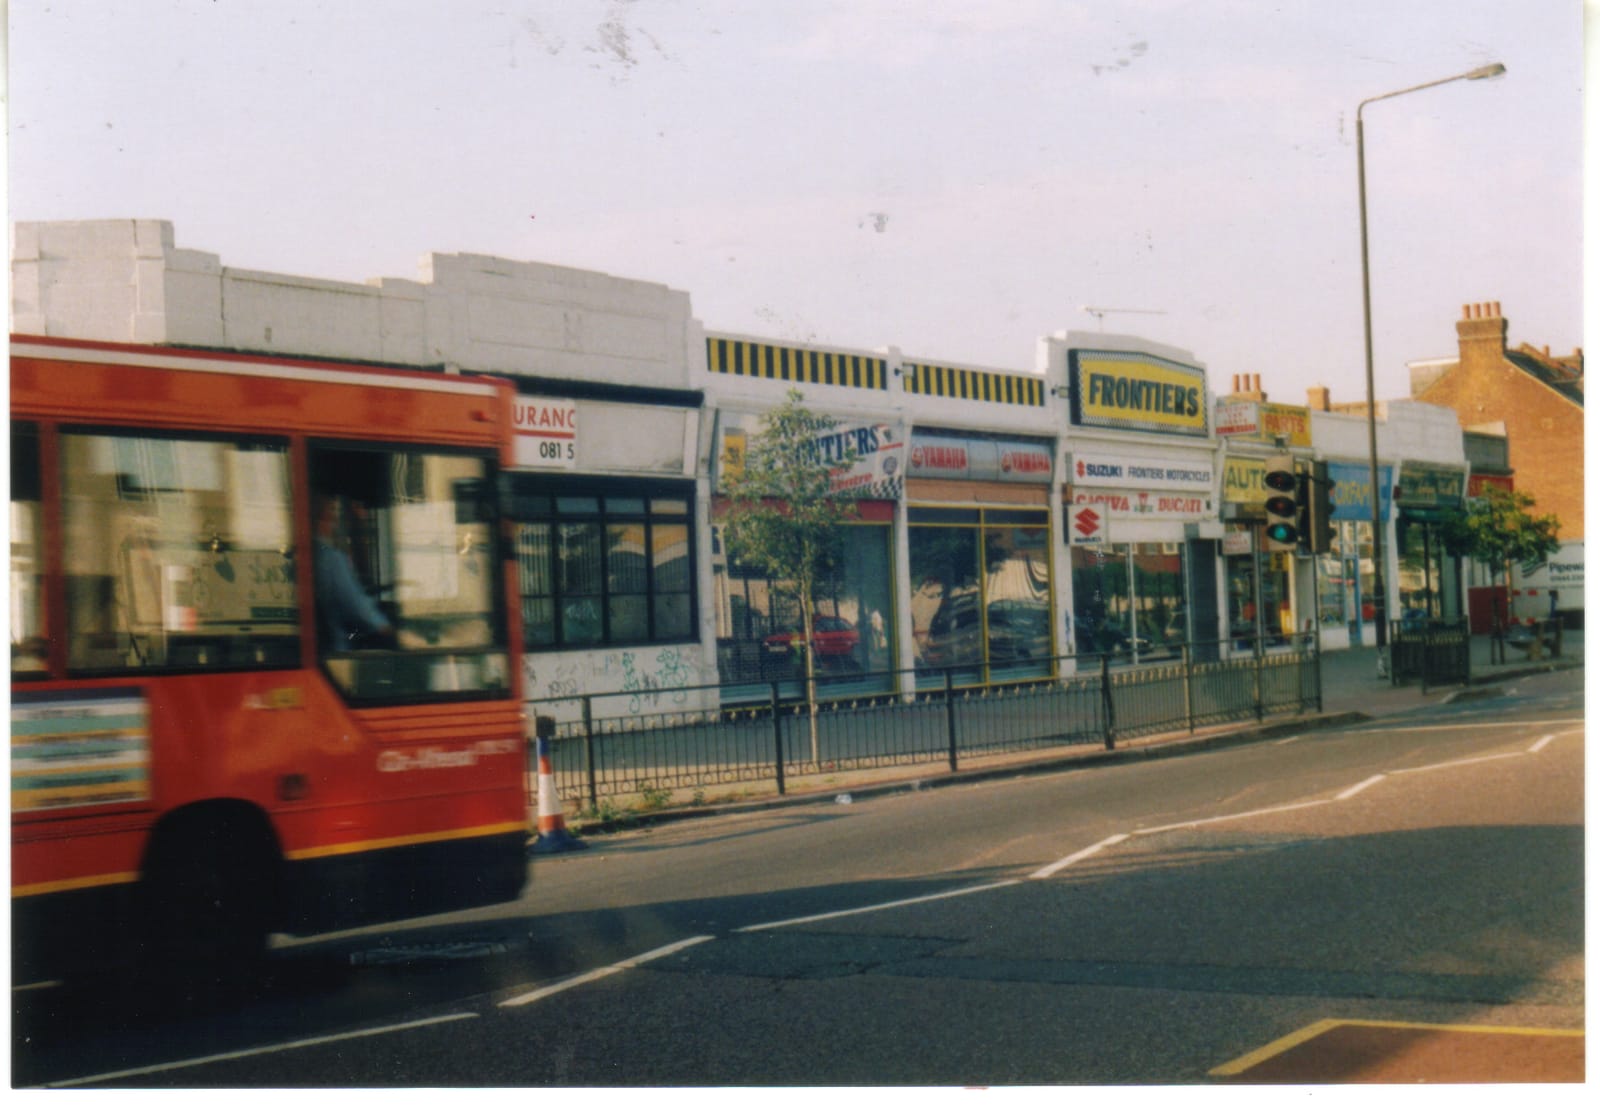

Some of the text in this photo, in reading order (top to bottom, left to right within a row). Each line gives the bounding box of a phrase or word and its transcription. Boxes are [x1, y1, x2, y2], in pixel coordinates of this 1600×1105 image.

[1088, 372, 1199, 417] FRONTIERS
[1264, 413, 1305, 433] PARTS
[539, 441, 561, 458] 081
[922, 445, 968, 469] YAMAHA
[1011, 451, 1051, 472] YAMAHA
[1086, 463, 1211, 482] SUZUKI FRONTIERS MOTORCYCLES
[1157, 497, 1202, 513] DUCATI
